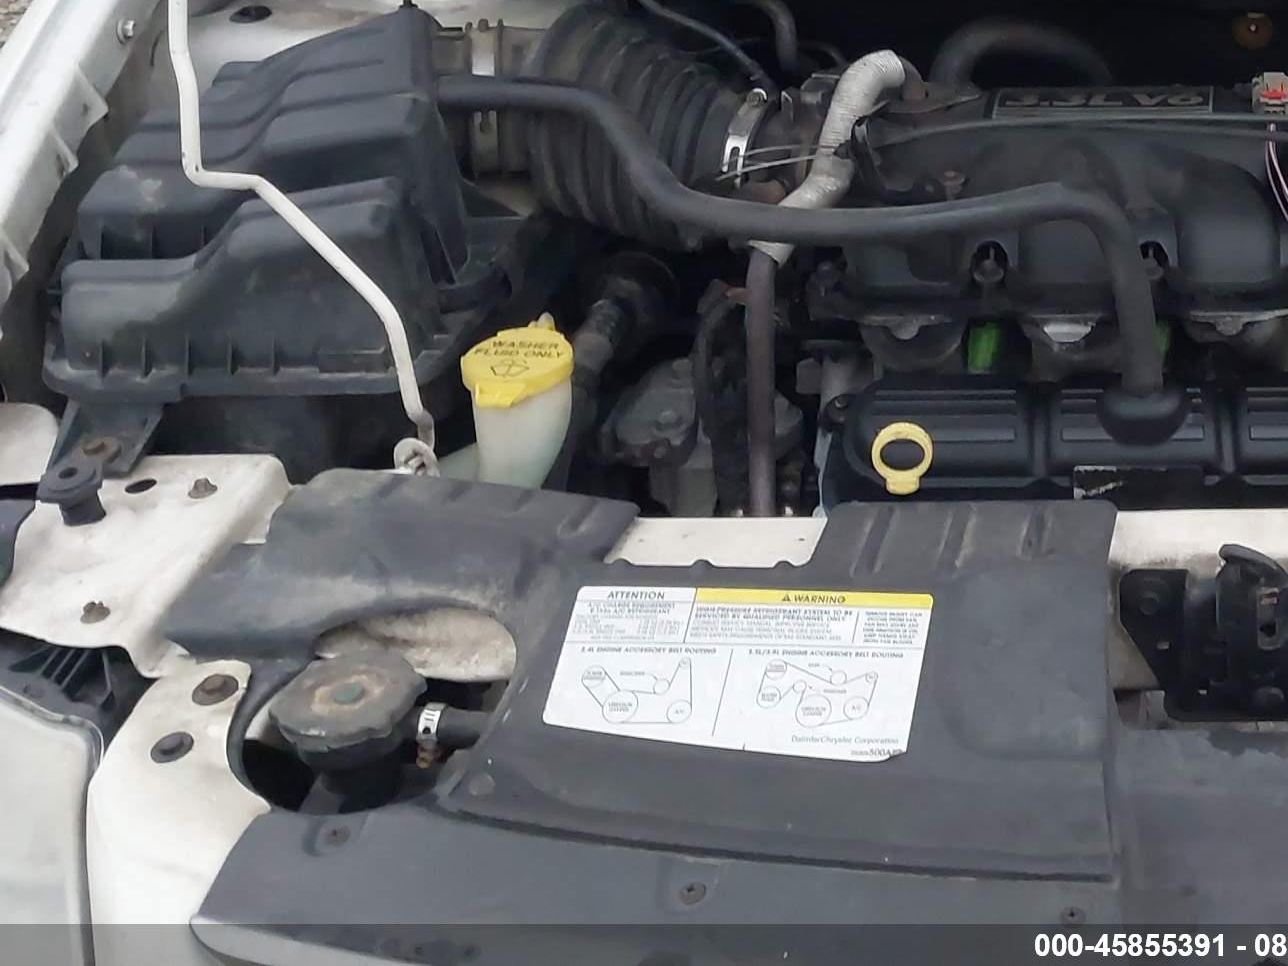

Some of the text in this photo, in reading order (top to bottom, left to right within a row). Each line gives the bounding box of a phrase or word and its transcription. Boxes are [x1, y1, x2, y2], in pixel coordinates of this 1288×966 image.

[1132, 90, 1204, 107] V6
[493, 340, 559, 350] WASHER
[474, 348, 564, 359] FLUID ONLY
[607, 591, 665, 600] ATTENTION
[794, 594, 846, 604] WARNING
[791, 734, 899, 745] DaimlerChrysler Corporation
